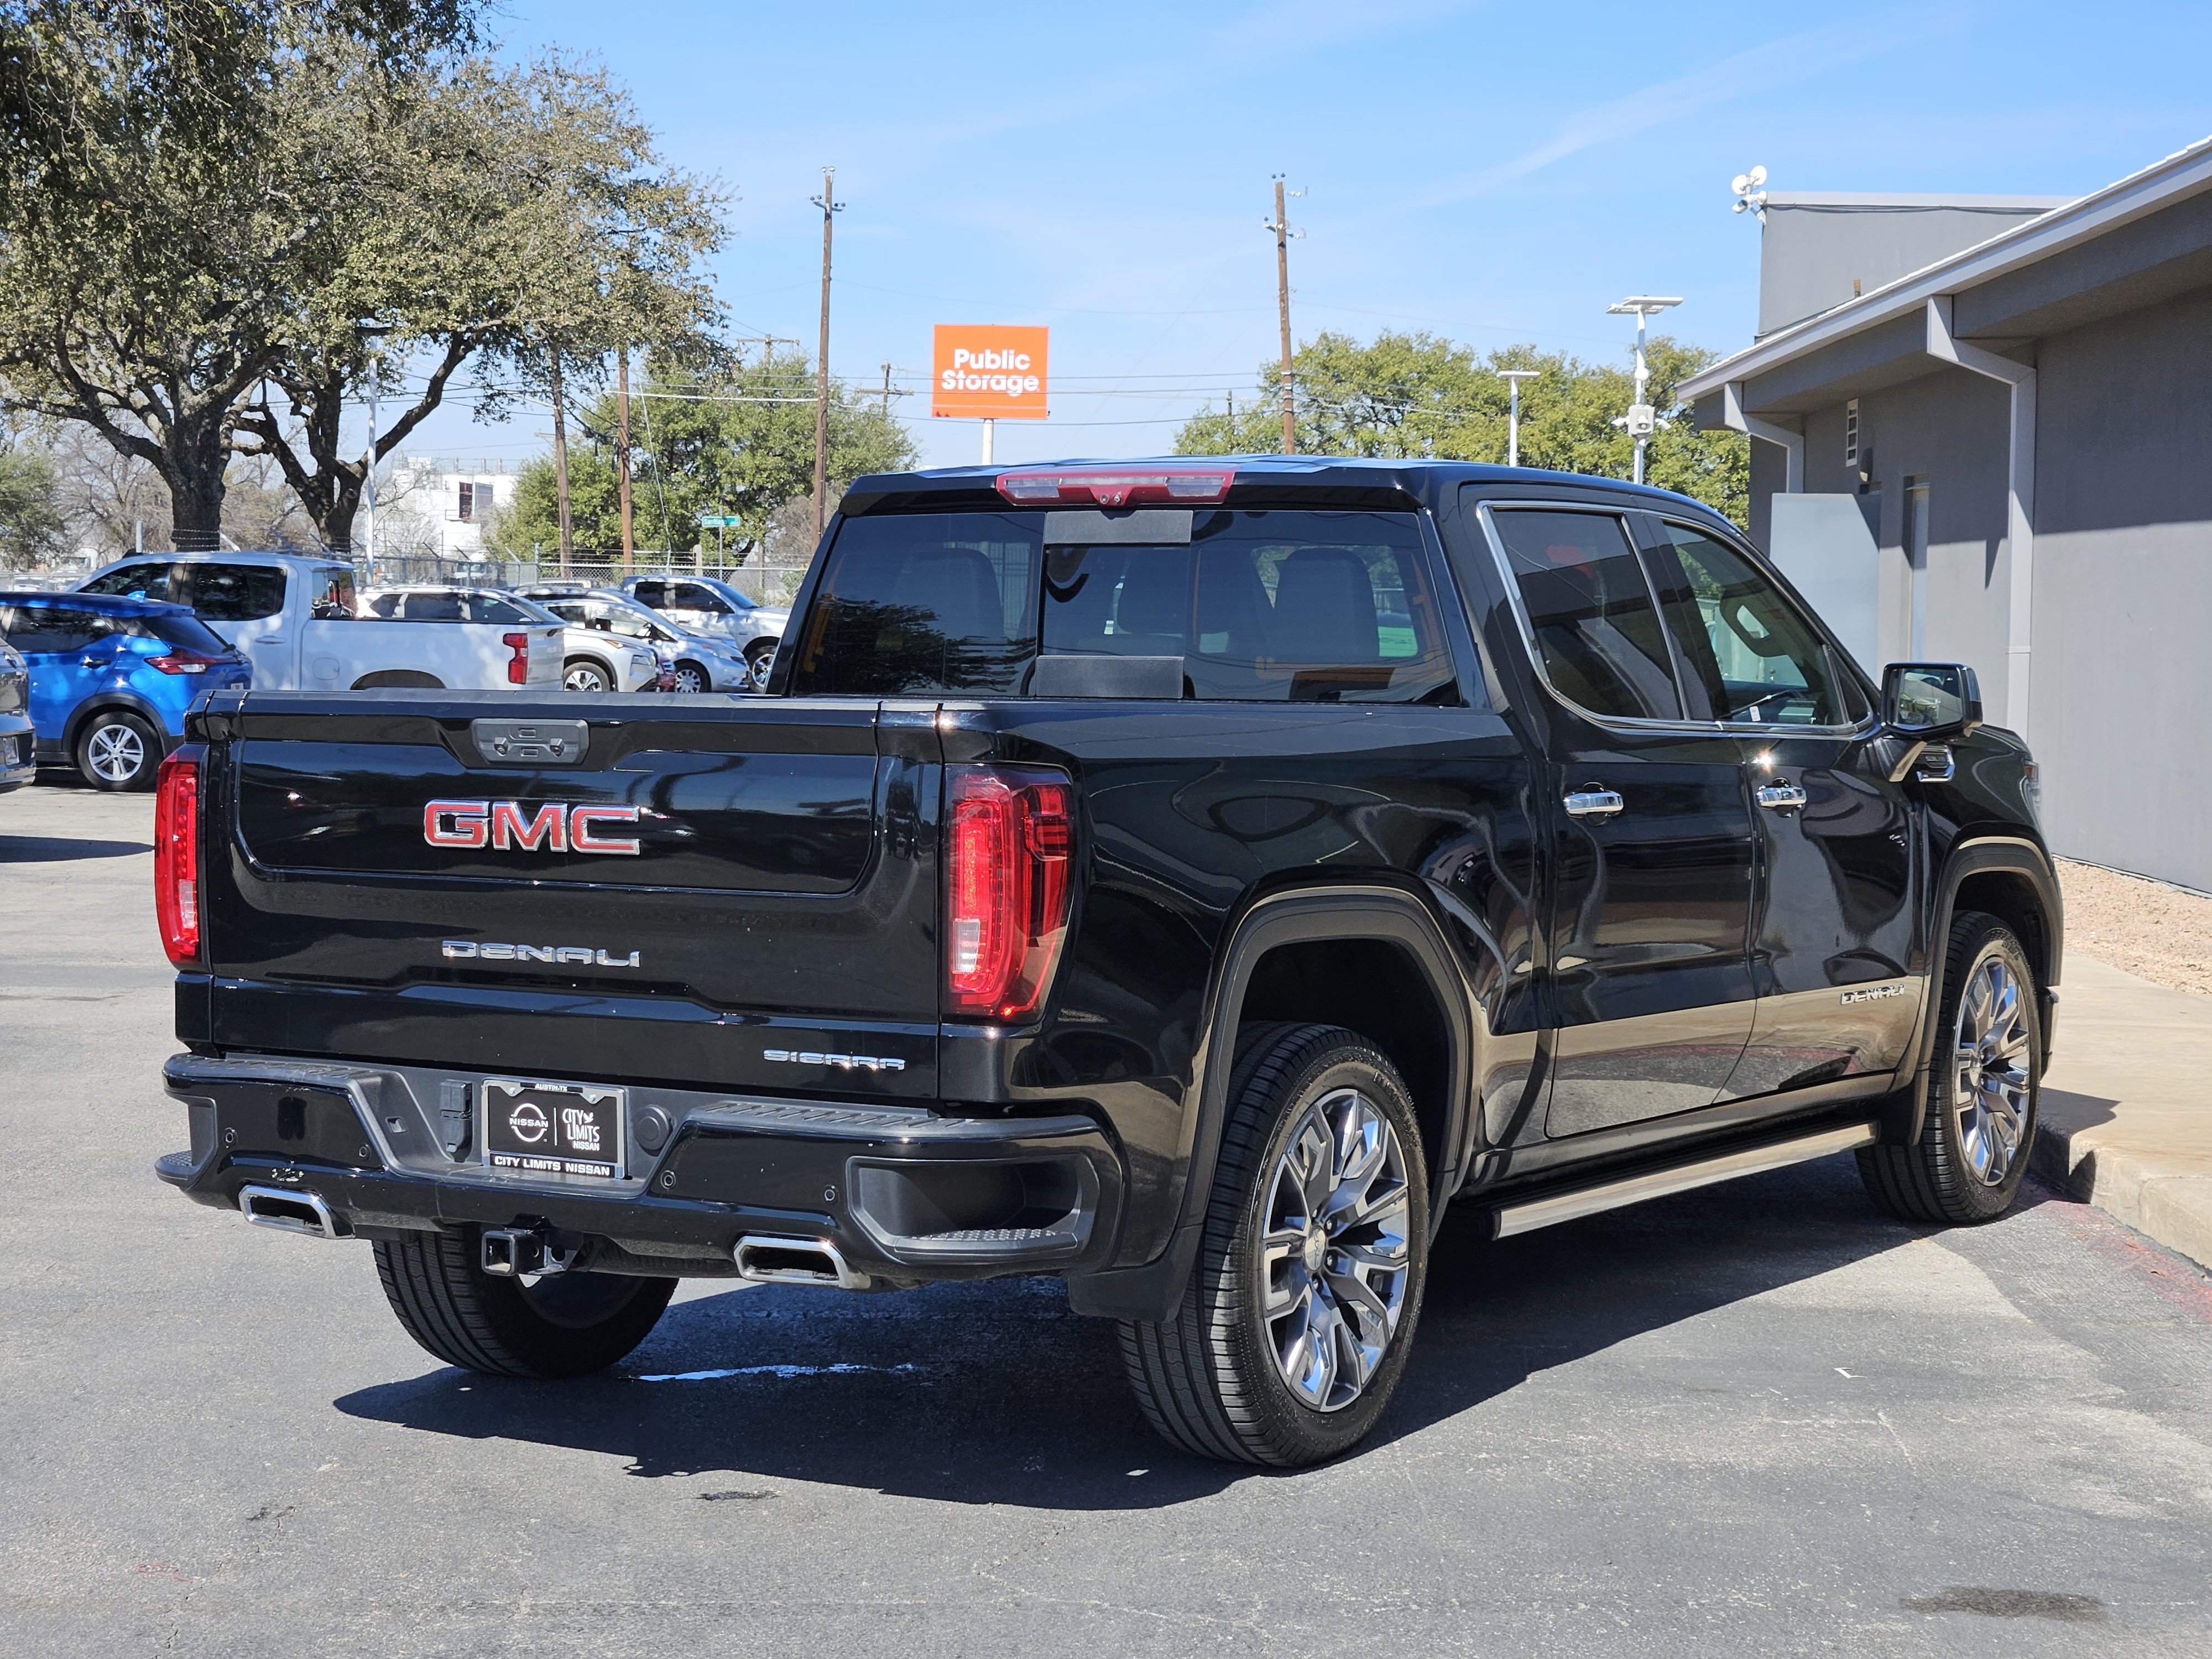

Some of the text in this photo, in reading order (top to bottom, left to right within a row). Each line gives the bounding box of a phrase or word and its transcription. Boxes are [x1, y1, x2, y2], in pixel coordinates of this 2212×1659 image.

[954, 348, 1031, 370] Public
[424, 799, 640, 855] GMC
[442, 940, 640, 968] DENALI
[1840, 984, 1905, 1005] DENALI
[764, 1050, 905, 1071] SIERRA
[509, 1117, 549, 1128] NISSAN
[562, 1108, 584, 1124] CITY
[567, 1123, 600, 1142] LIMITS
[573, 1140, 600, 1151] NISSAN
[495, 1155, 610, 1176] CITY LIMITS NISSAN
